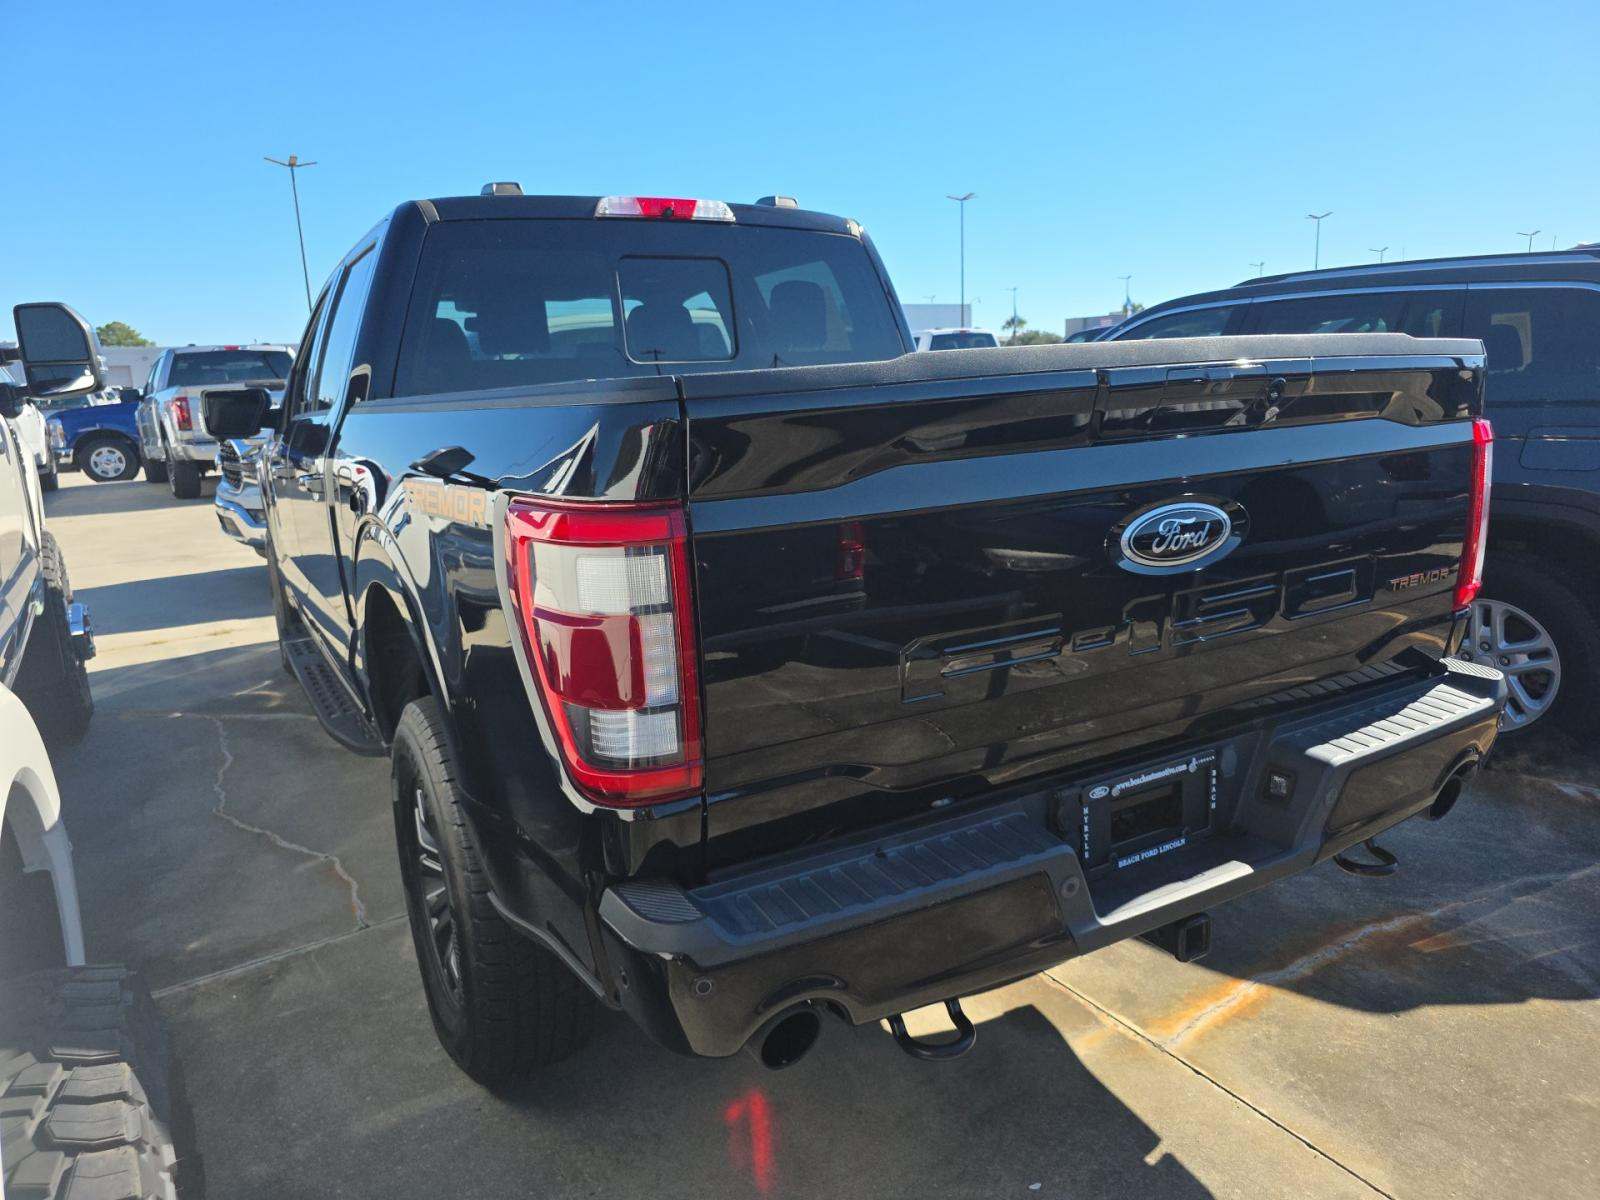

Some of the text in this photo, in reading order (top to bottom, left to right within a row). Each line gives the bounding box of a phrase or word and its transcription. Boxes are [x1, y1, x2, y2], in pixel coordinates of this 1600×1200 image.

[402, 481, 487, 526] TREMOR
[1152, 516, 1211, 554] Ford
[1391, 567, 1449, 592] TREMOR
[1118, 838, 1186, 868] BEACH FORD LINCOLN
